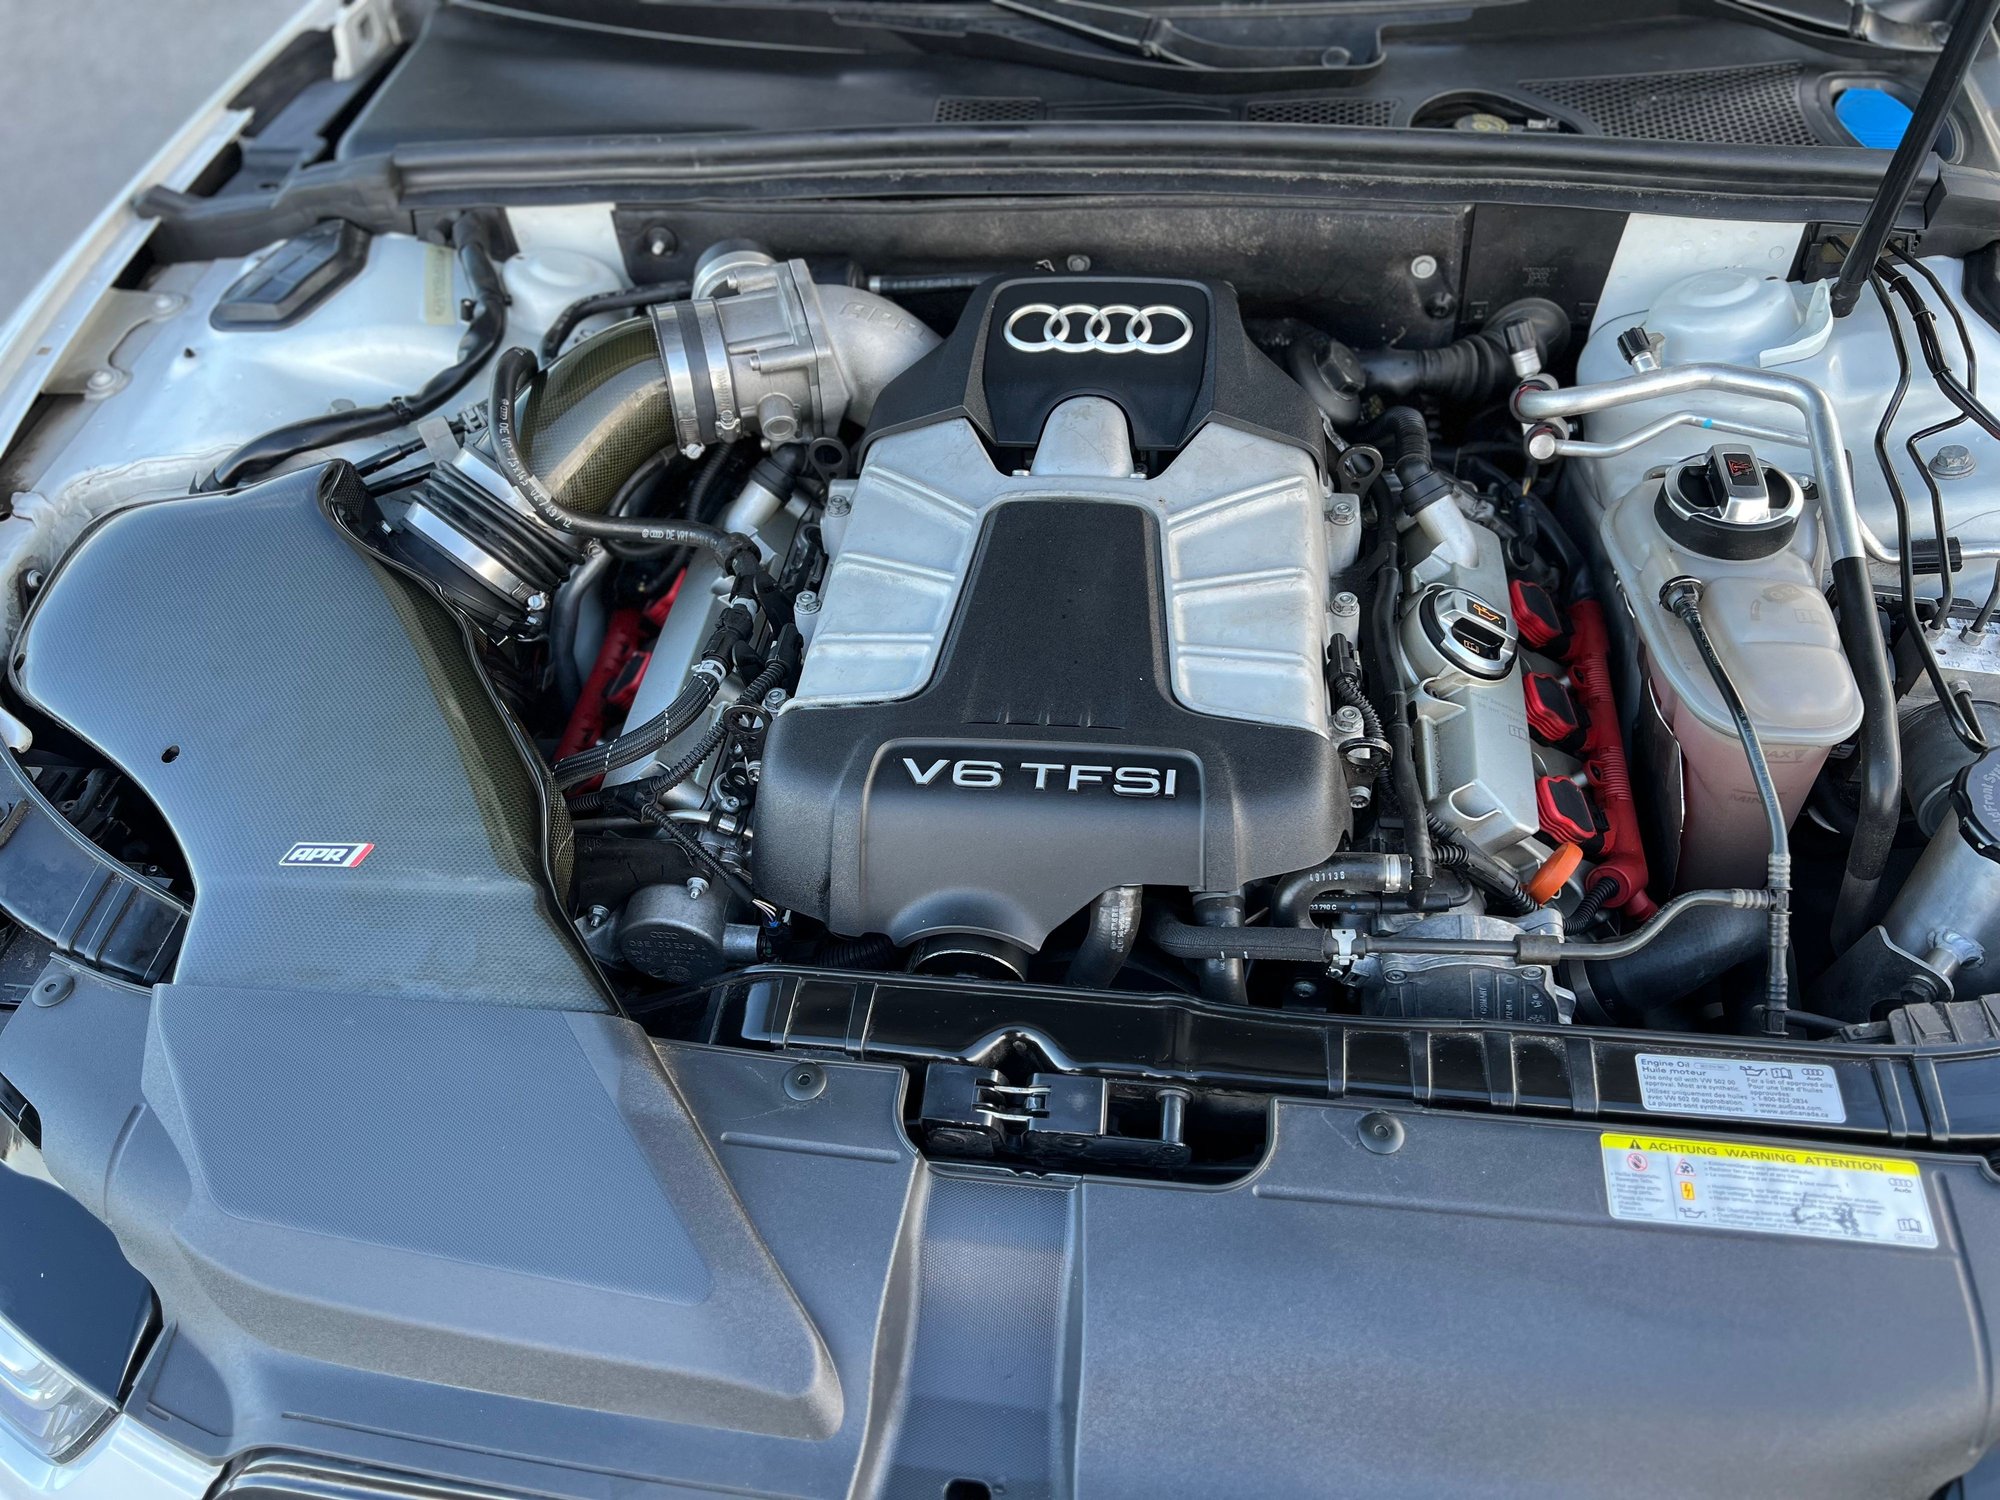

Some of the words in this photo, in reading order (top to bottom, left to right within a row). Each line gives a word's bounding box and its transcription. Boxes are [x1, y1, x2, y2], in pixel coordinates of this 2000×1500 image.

[902, 757, 1004, 790] V6
[1020, 762, 1178, 798] TFSI
[288, 847, 349, 862] APR
[1641, 1059, 1674, 1067] Engine
[1649, 1141, 1718, 1156] ACHTUNG
[1724, 1148, 1797, 1163] WARNING
[1804, 1155, 1885, 1172] ATTENTION
